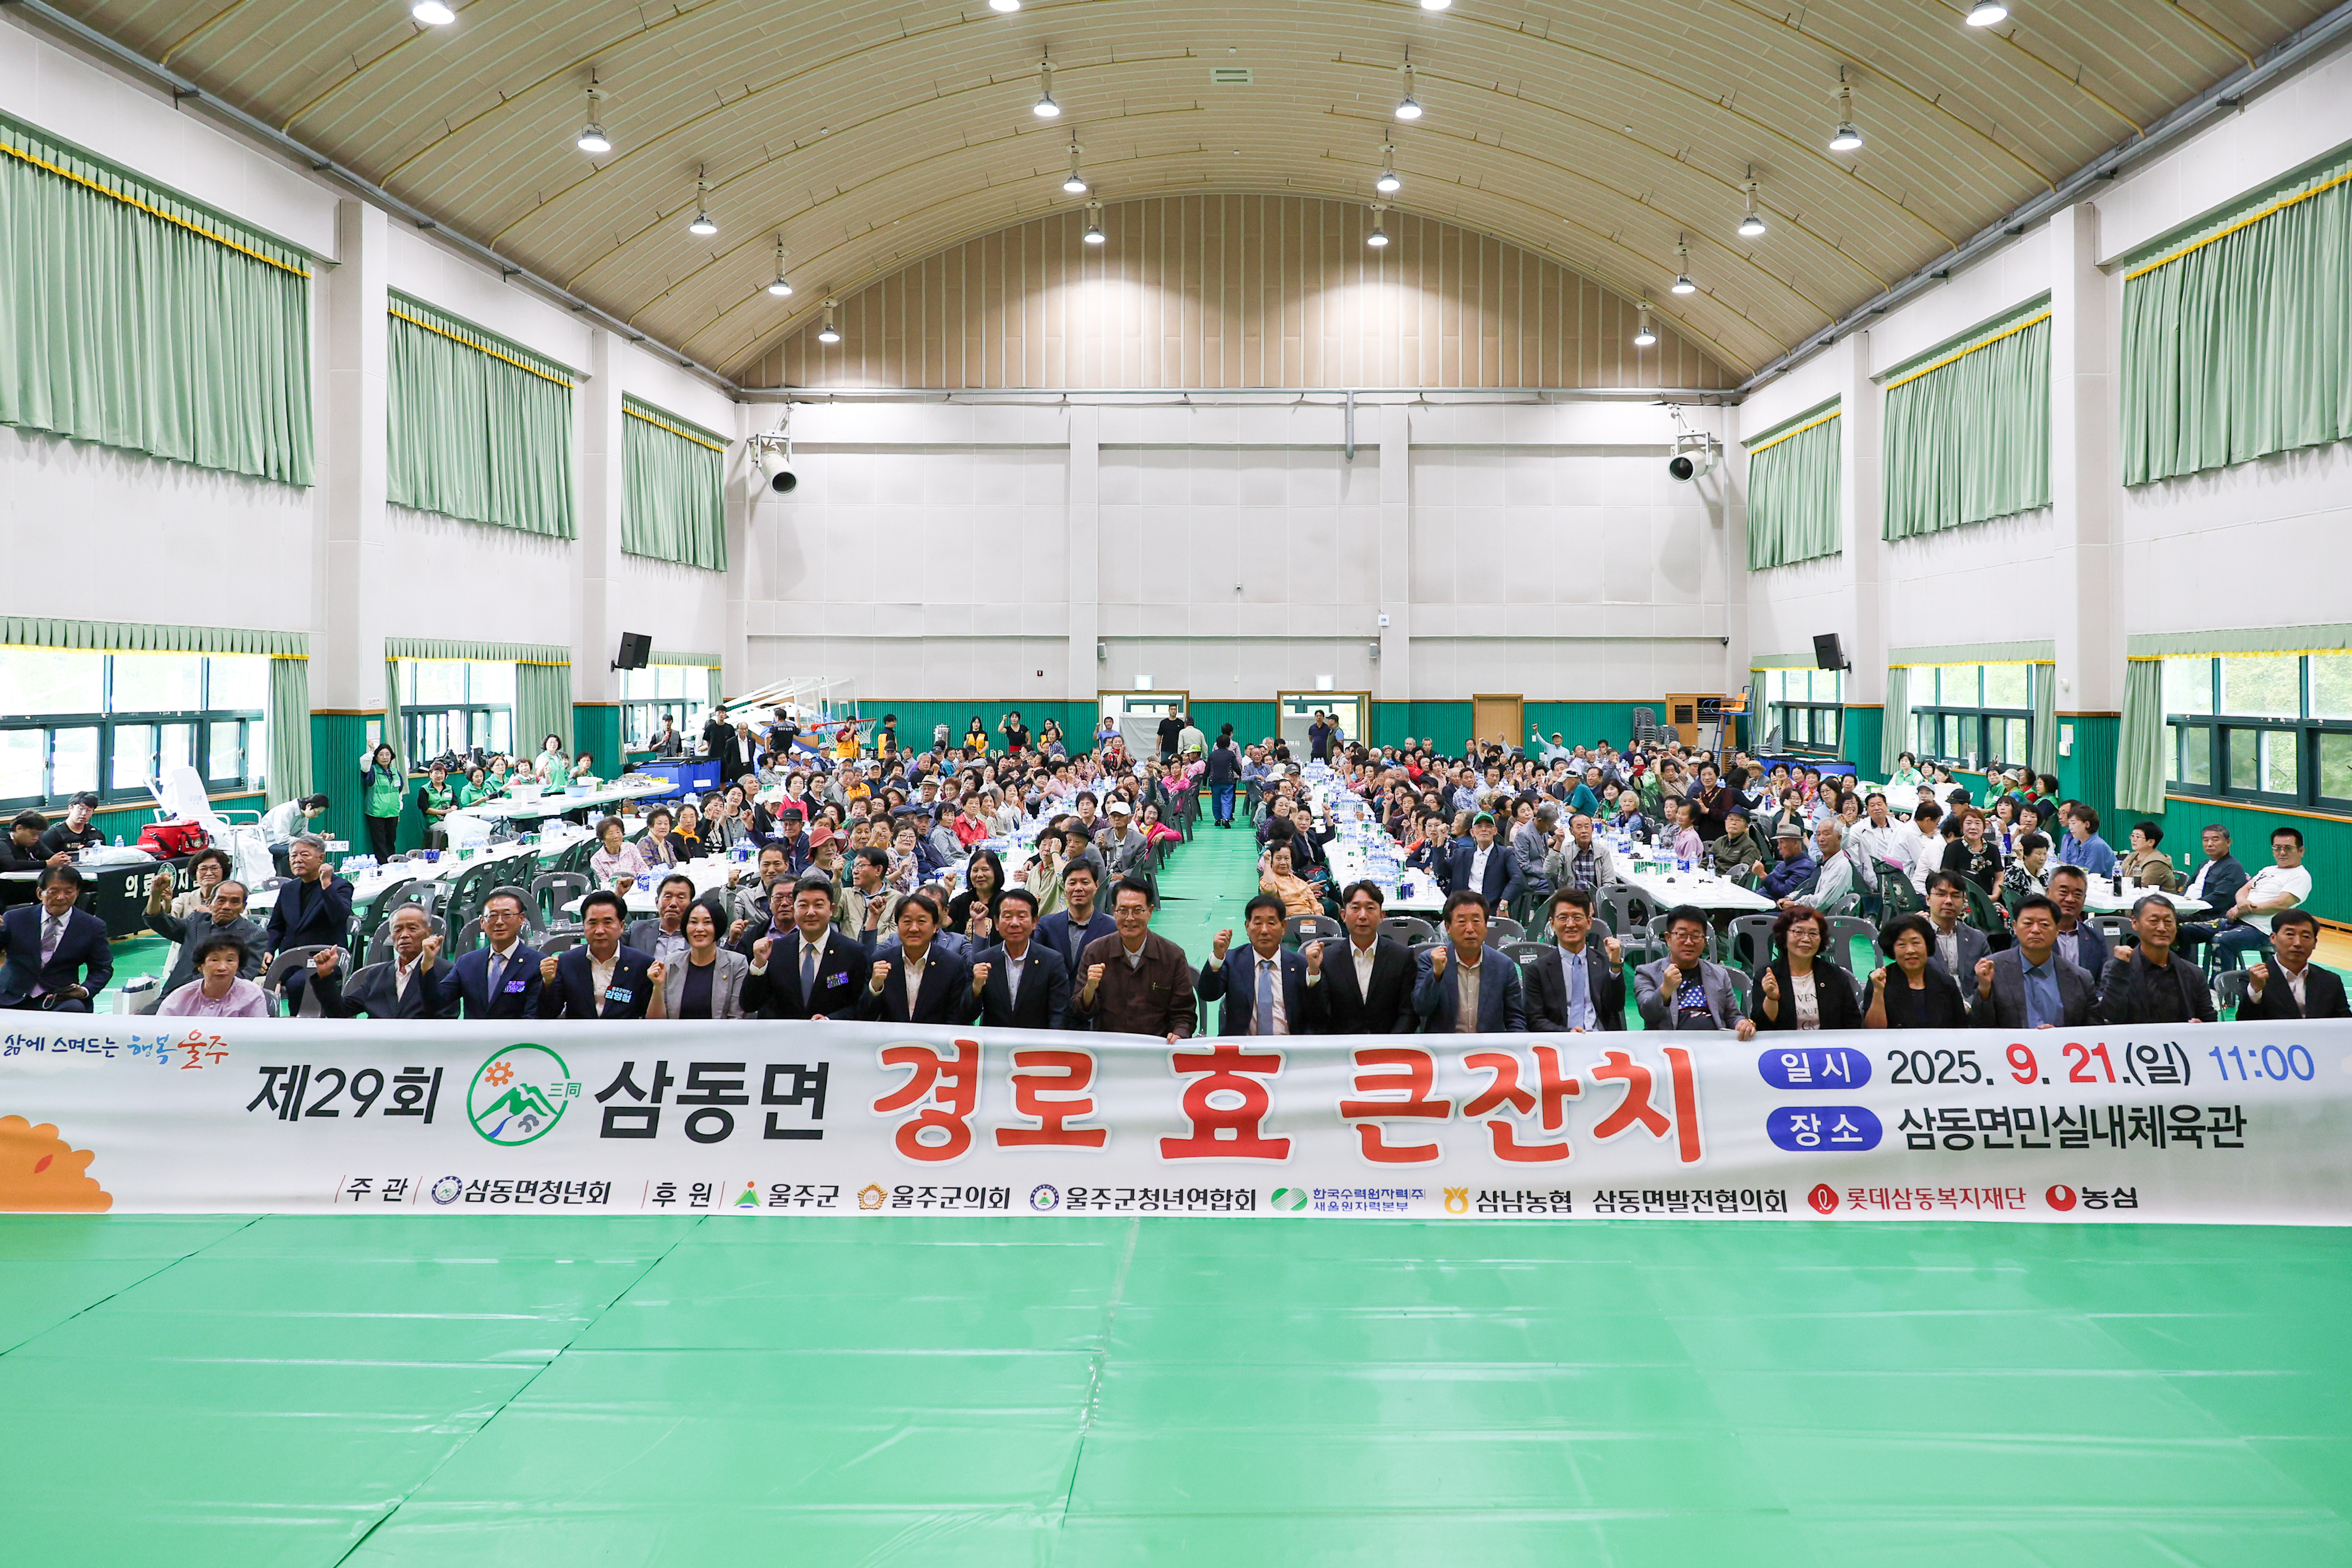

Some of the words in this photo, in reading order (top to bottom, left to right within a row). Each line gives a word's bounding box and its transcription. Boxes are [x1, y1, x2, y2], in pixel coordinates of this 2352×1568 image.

[4, 1034, 45, 1056] 삶에
[52, 1037, 119, 1058] 스며드는
[1888, 1050, 1994, 1085] 2025.
[2007, 1044, 2050, 1084] 9.
[2209, 1045, 2314, 1081] 11:00
[246, 1065, 443, 1123] 제29회
[594, 1061, 829, 1144] 삼동면
[875, 1040, 1106, 1161] 경로
[1161, 1046, 1290, 1159] 효
[547, 1083, 582, 1099] 三同
[1898, 1105, 2247, 1150] 삼동면민실내체육관
[465, 1180, 611, 1204] 삼동면청년회
[769, 1184, 839, 1207] 울주군
[893, 1186, 1010, 1209] 울주군의회
[1067, 1188, 1255, 1211] 울주군청년연합회
[1477, 1190, 1572, 1212] 삼남농협
[1593, 1189, 1787, 1212] 삼동면발전협의회
[1849, 1188, 2025, 1210] 롯데삼동복지재단
[2082, 1187, 2138, 1209] 농심
[1315, 1202, 1407, 1211] 새울원자력본부
